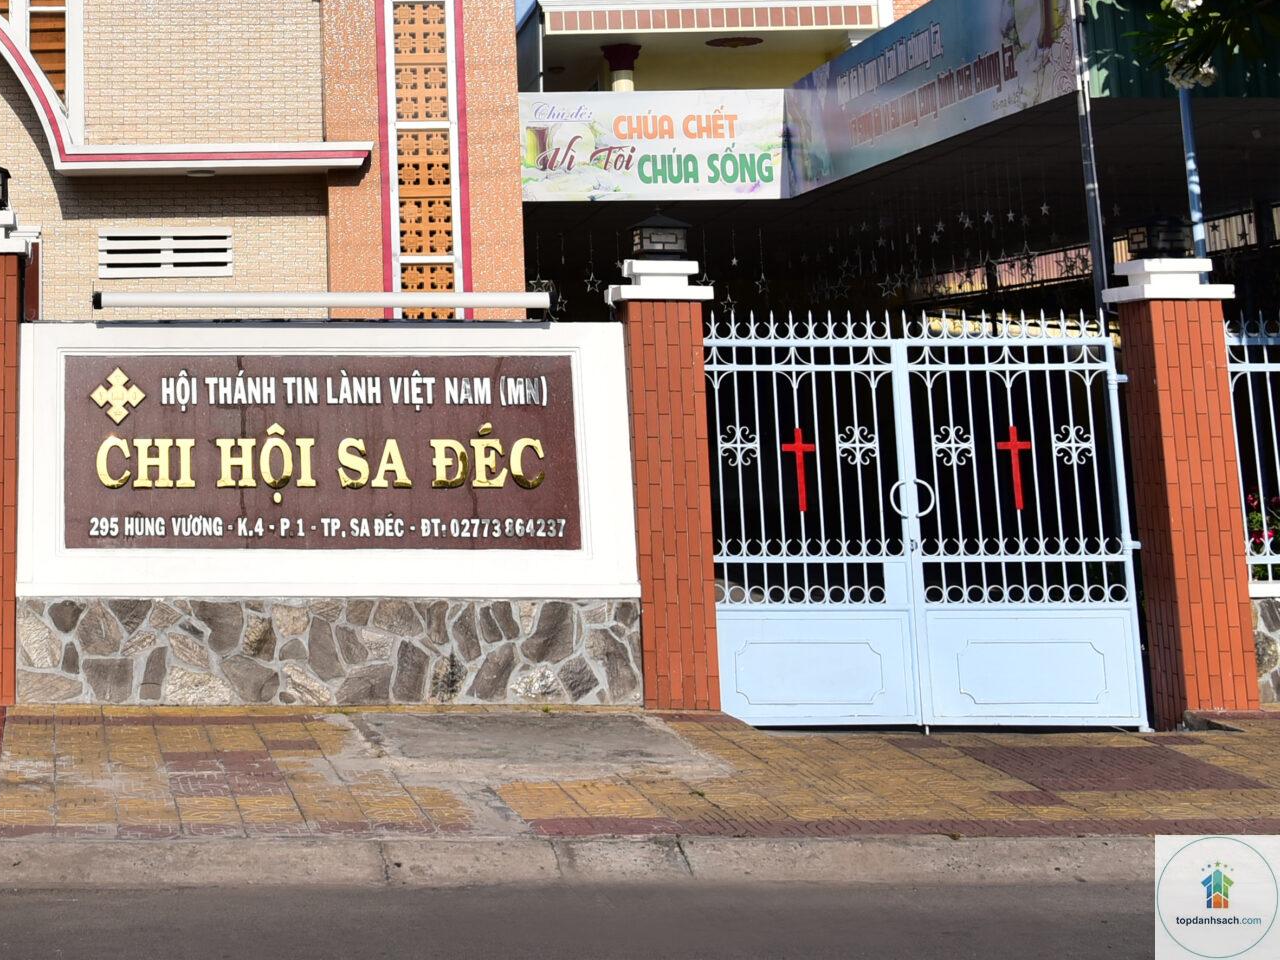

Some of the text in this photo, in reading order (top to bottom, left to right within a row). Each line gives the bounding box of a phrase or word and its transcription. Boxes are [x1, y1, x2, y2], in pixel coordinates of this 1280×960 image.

[613, 105, 737, 139] CHÚA CHẾT
[536, 135, 636, 171] Vì Tôi
[638, 142, 774, 184] CHÚA SỐNG
[161, 370, 547, 411] HỘI THÁNH TIN LÀNH VIỆT NAM (MN)
[95, 421, 546, 505] CHI HỘI SA ĐÉC
[89, 517, 119, 536] 295
[171, 514, 223, 536] VƯƠNG
[237, 517, 264, 537] K.4
[350, 518, 370, 537] SA
[374, 513, 404, 537] ĐÉC
[420, 518, 447, 537] ĐT:
[450, 518, 502, 538] 02773
[505, 518, 566, 538] 864237
